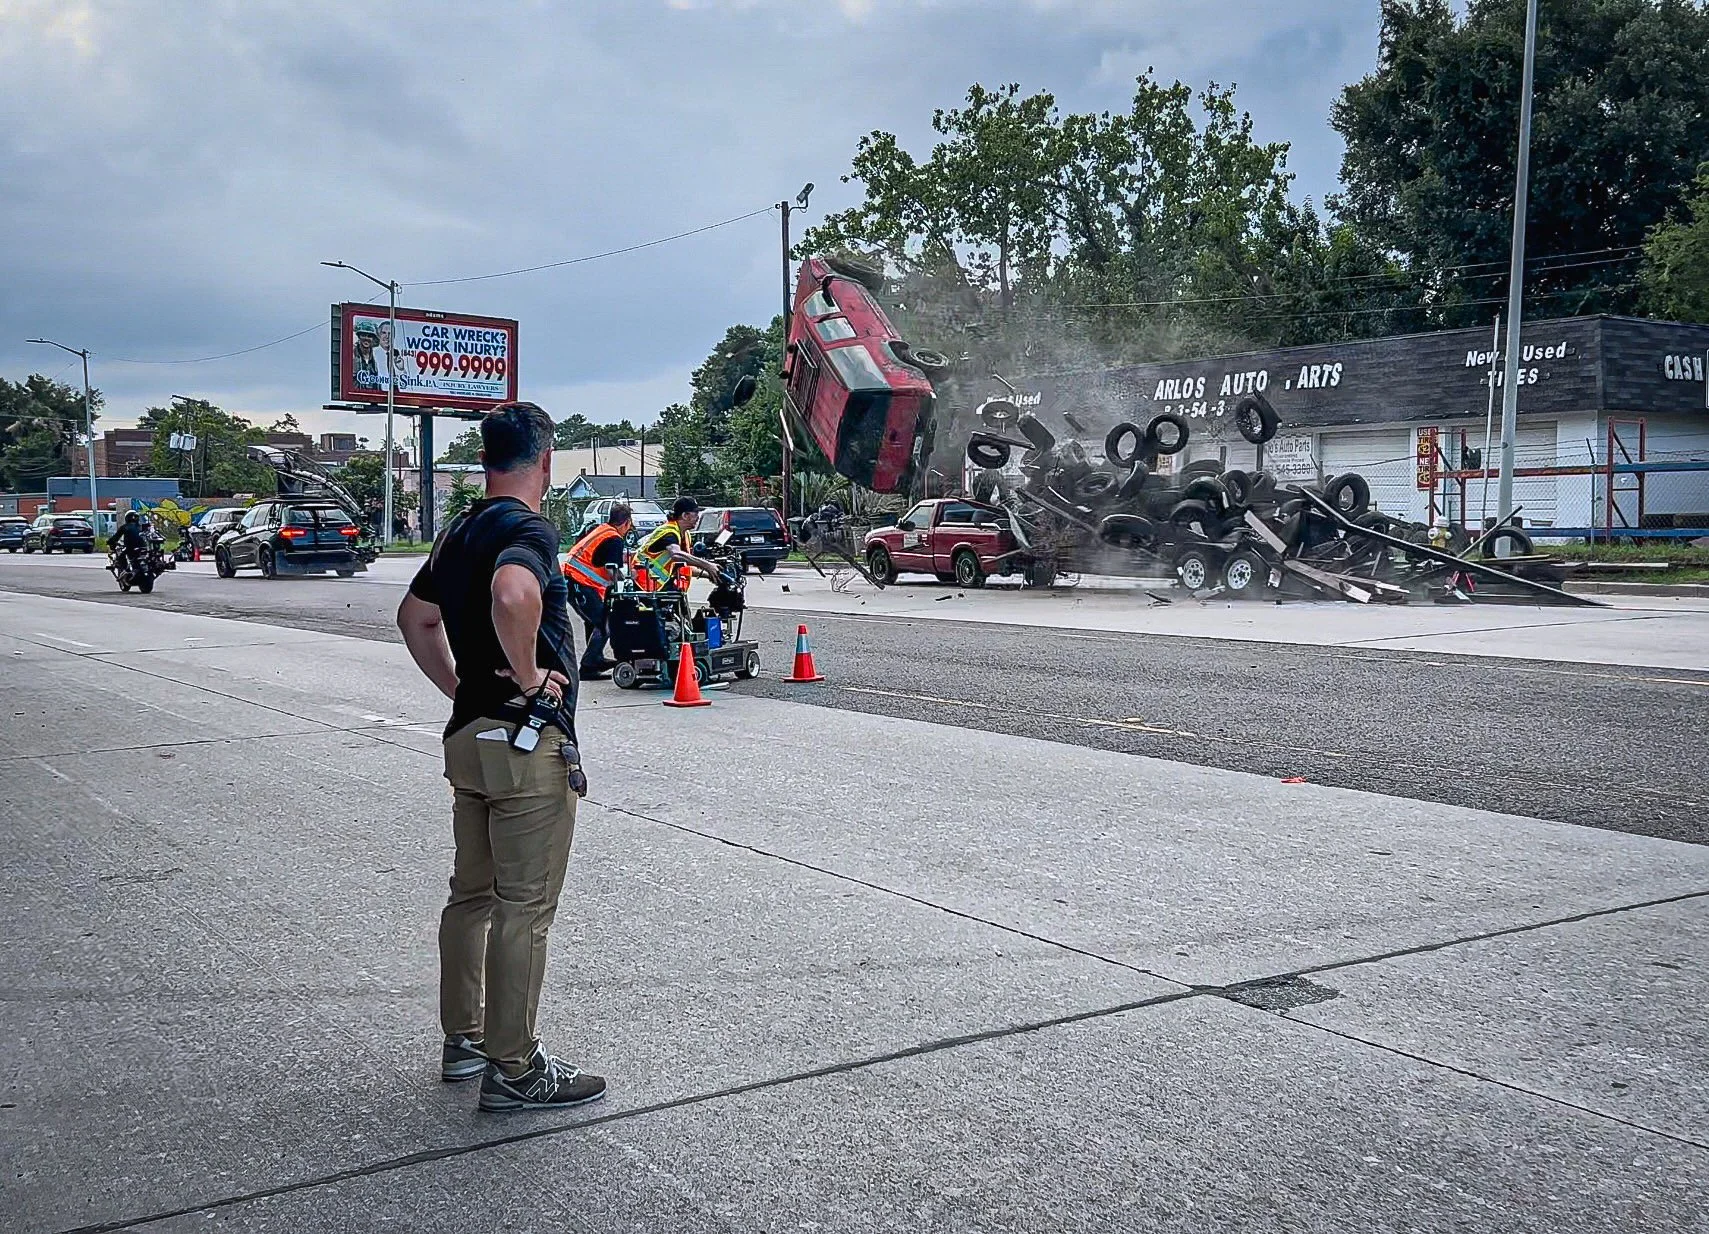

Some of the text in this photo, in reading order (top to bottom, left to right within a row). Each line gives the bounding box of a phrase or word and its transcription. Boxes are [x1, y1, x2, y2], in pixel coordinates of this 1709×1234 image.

[421, 325, 507, 345] CAR WRECK?
[406, 337, 507, 357] WORK INJURY?
[1465, 341, 1567, 367] New Used
[1487, 367, 1539, 388] TIES
[1664, 354, 1704, 381] CASH
[467, 383, 499, 391] LAWYERS
[1219, 370, 1268, 397] AUTO
[1285, 362, 1343, 391] ARTS
[1015, 391, 1042, 407] Used
[1279, 440, 1294, 453] Auto
[1294, 439, 1310, 452] Parts
